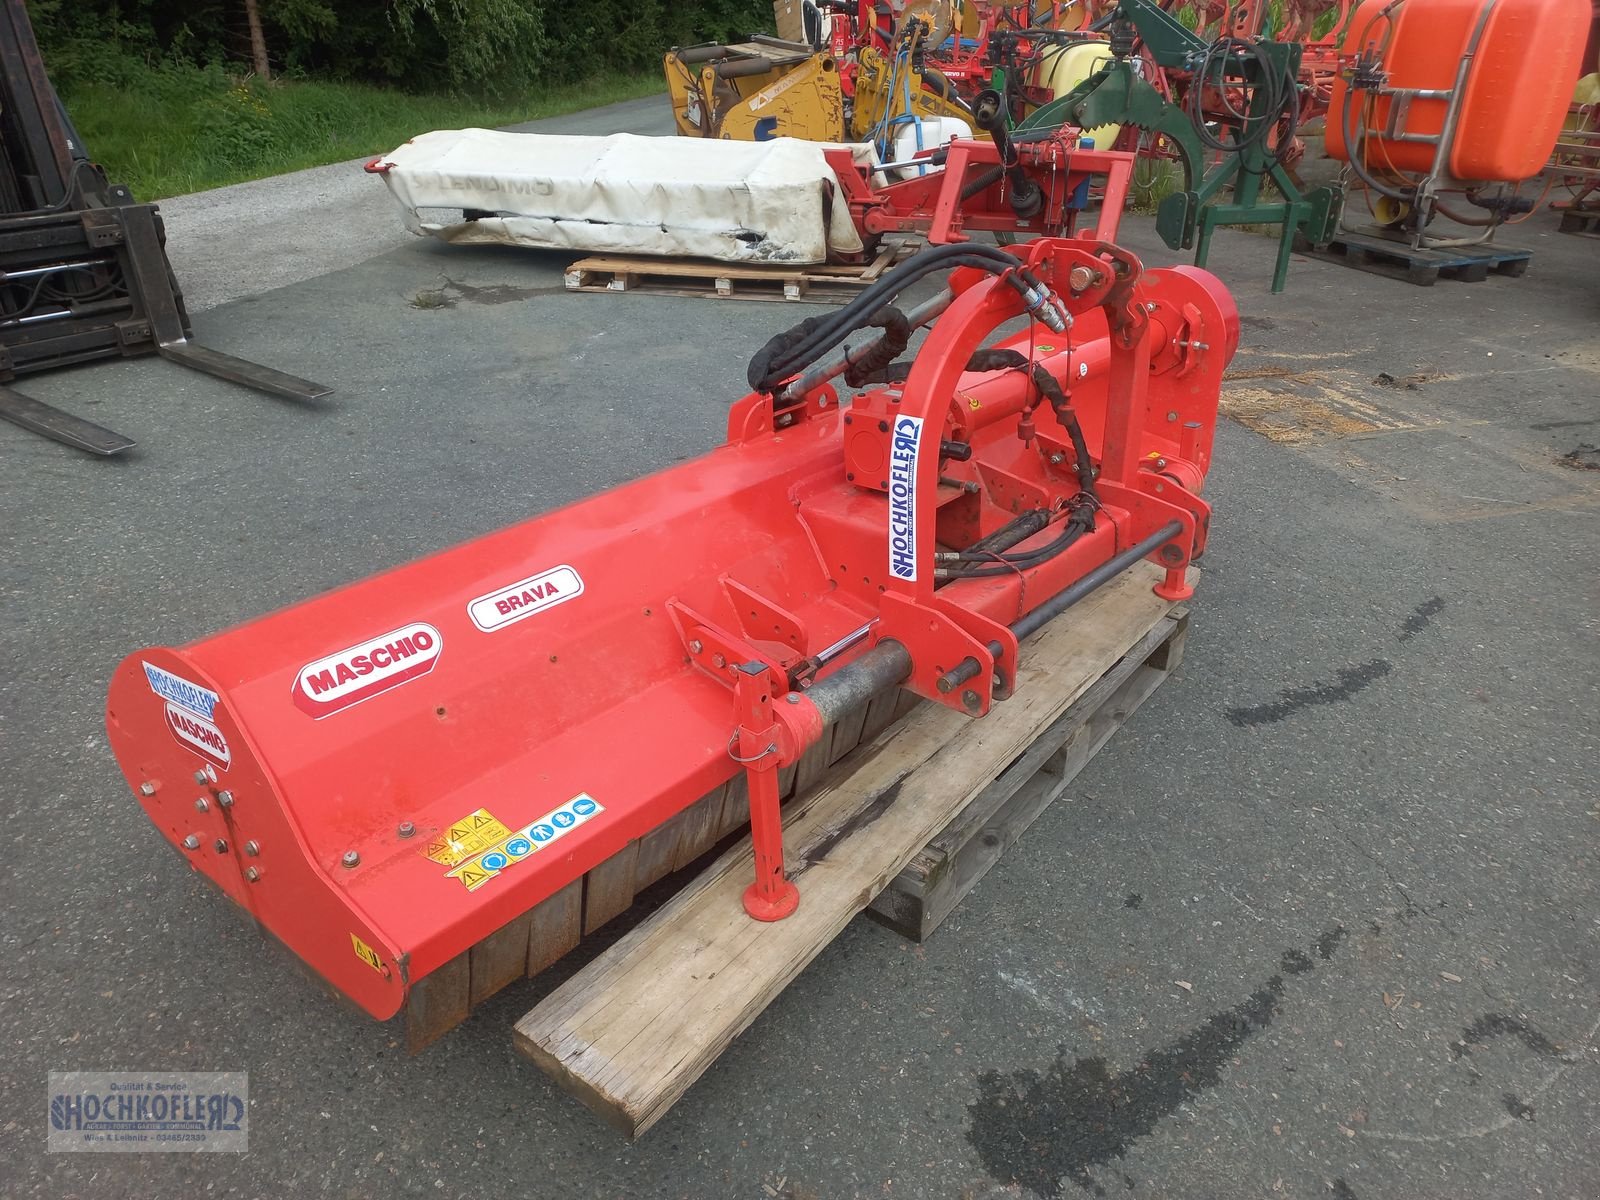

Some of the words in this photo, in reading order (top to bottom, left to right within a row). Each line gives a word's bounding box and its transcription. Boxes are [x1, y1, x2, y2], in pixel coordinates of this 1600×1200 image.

[891, 437, 917, 568] HOCHKOFLER
[495, 581, 560, 616] BRAVA
[306, 631, 433, 695] MASCHIO
[169, 709, 226, 754] MASCHIO
